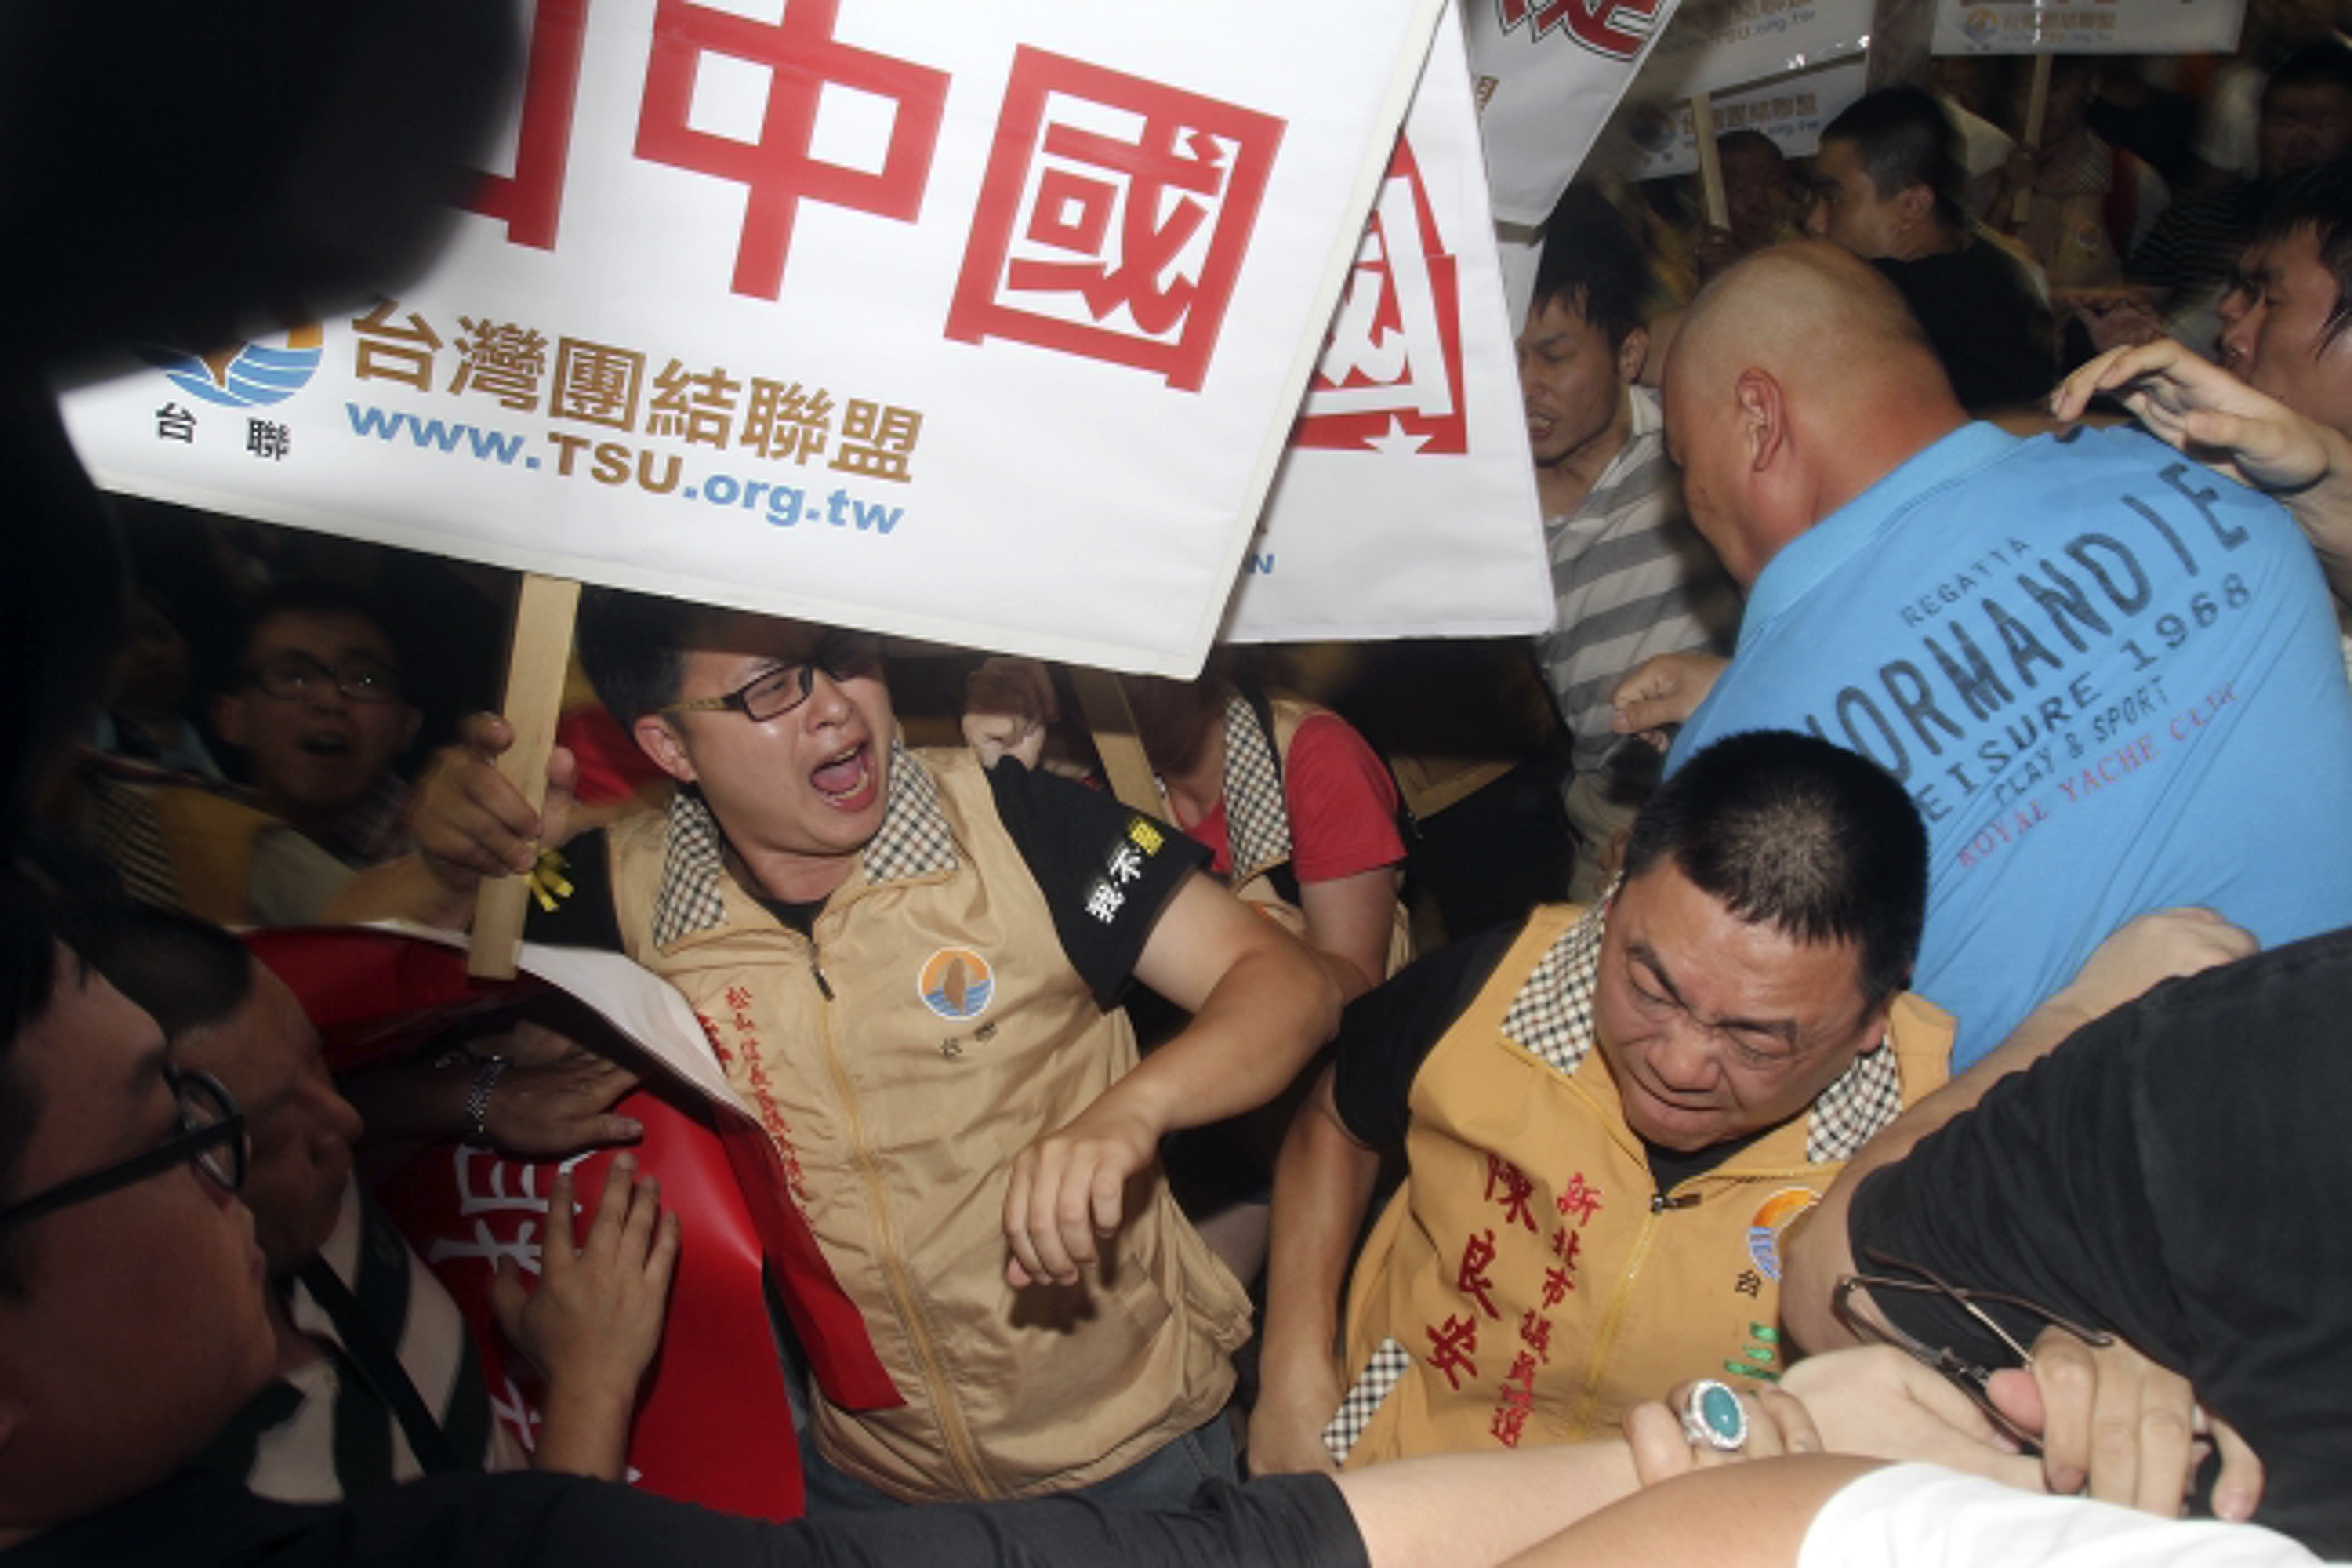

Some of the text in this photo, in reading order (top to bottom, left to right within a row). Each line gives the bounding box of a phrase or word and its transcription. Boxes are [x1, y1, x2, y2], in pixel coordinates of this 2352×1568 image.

[345, 401, 905, 535] www.TSU.org.tw
[351, 295, 925, 484] 台灣團結聯盟
[1803, 464, 2251, 783] ORMANDIE
[1898, 536, 2031, 629] REGATTA
[1912, 572, 2252, 823] EISURE 1968
[2063, 730, 2085, 760] &
[2091, 674, 2173, 743] SPORT
